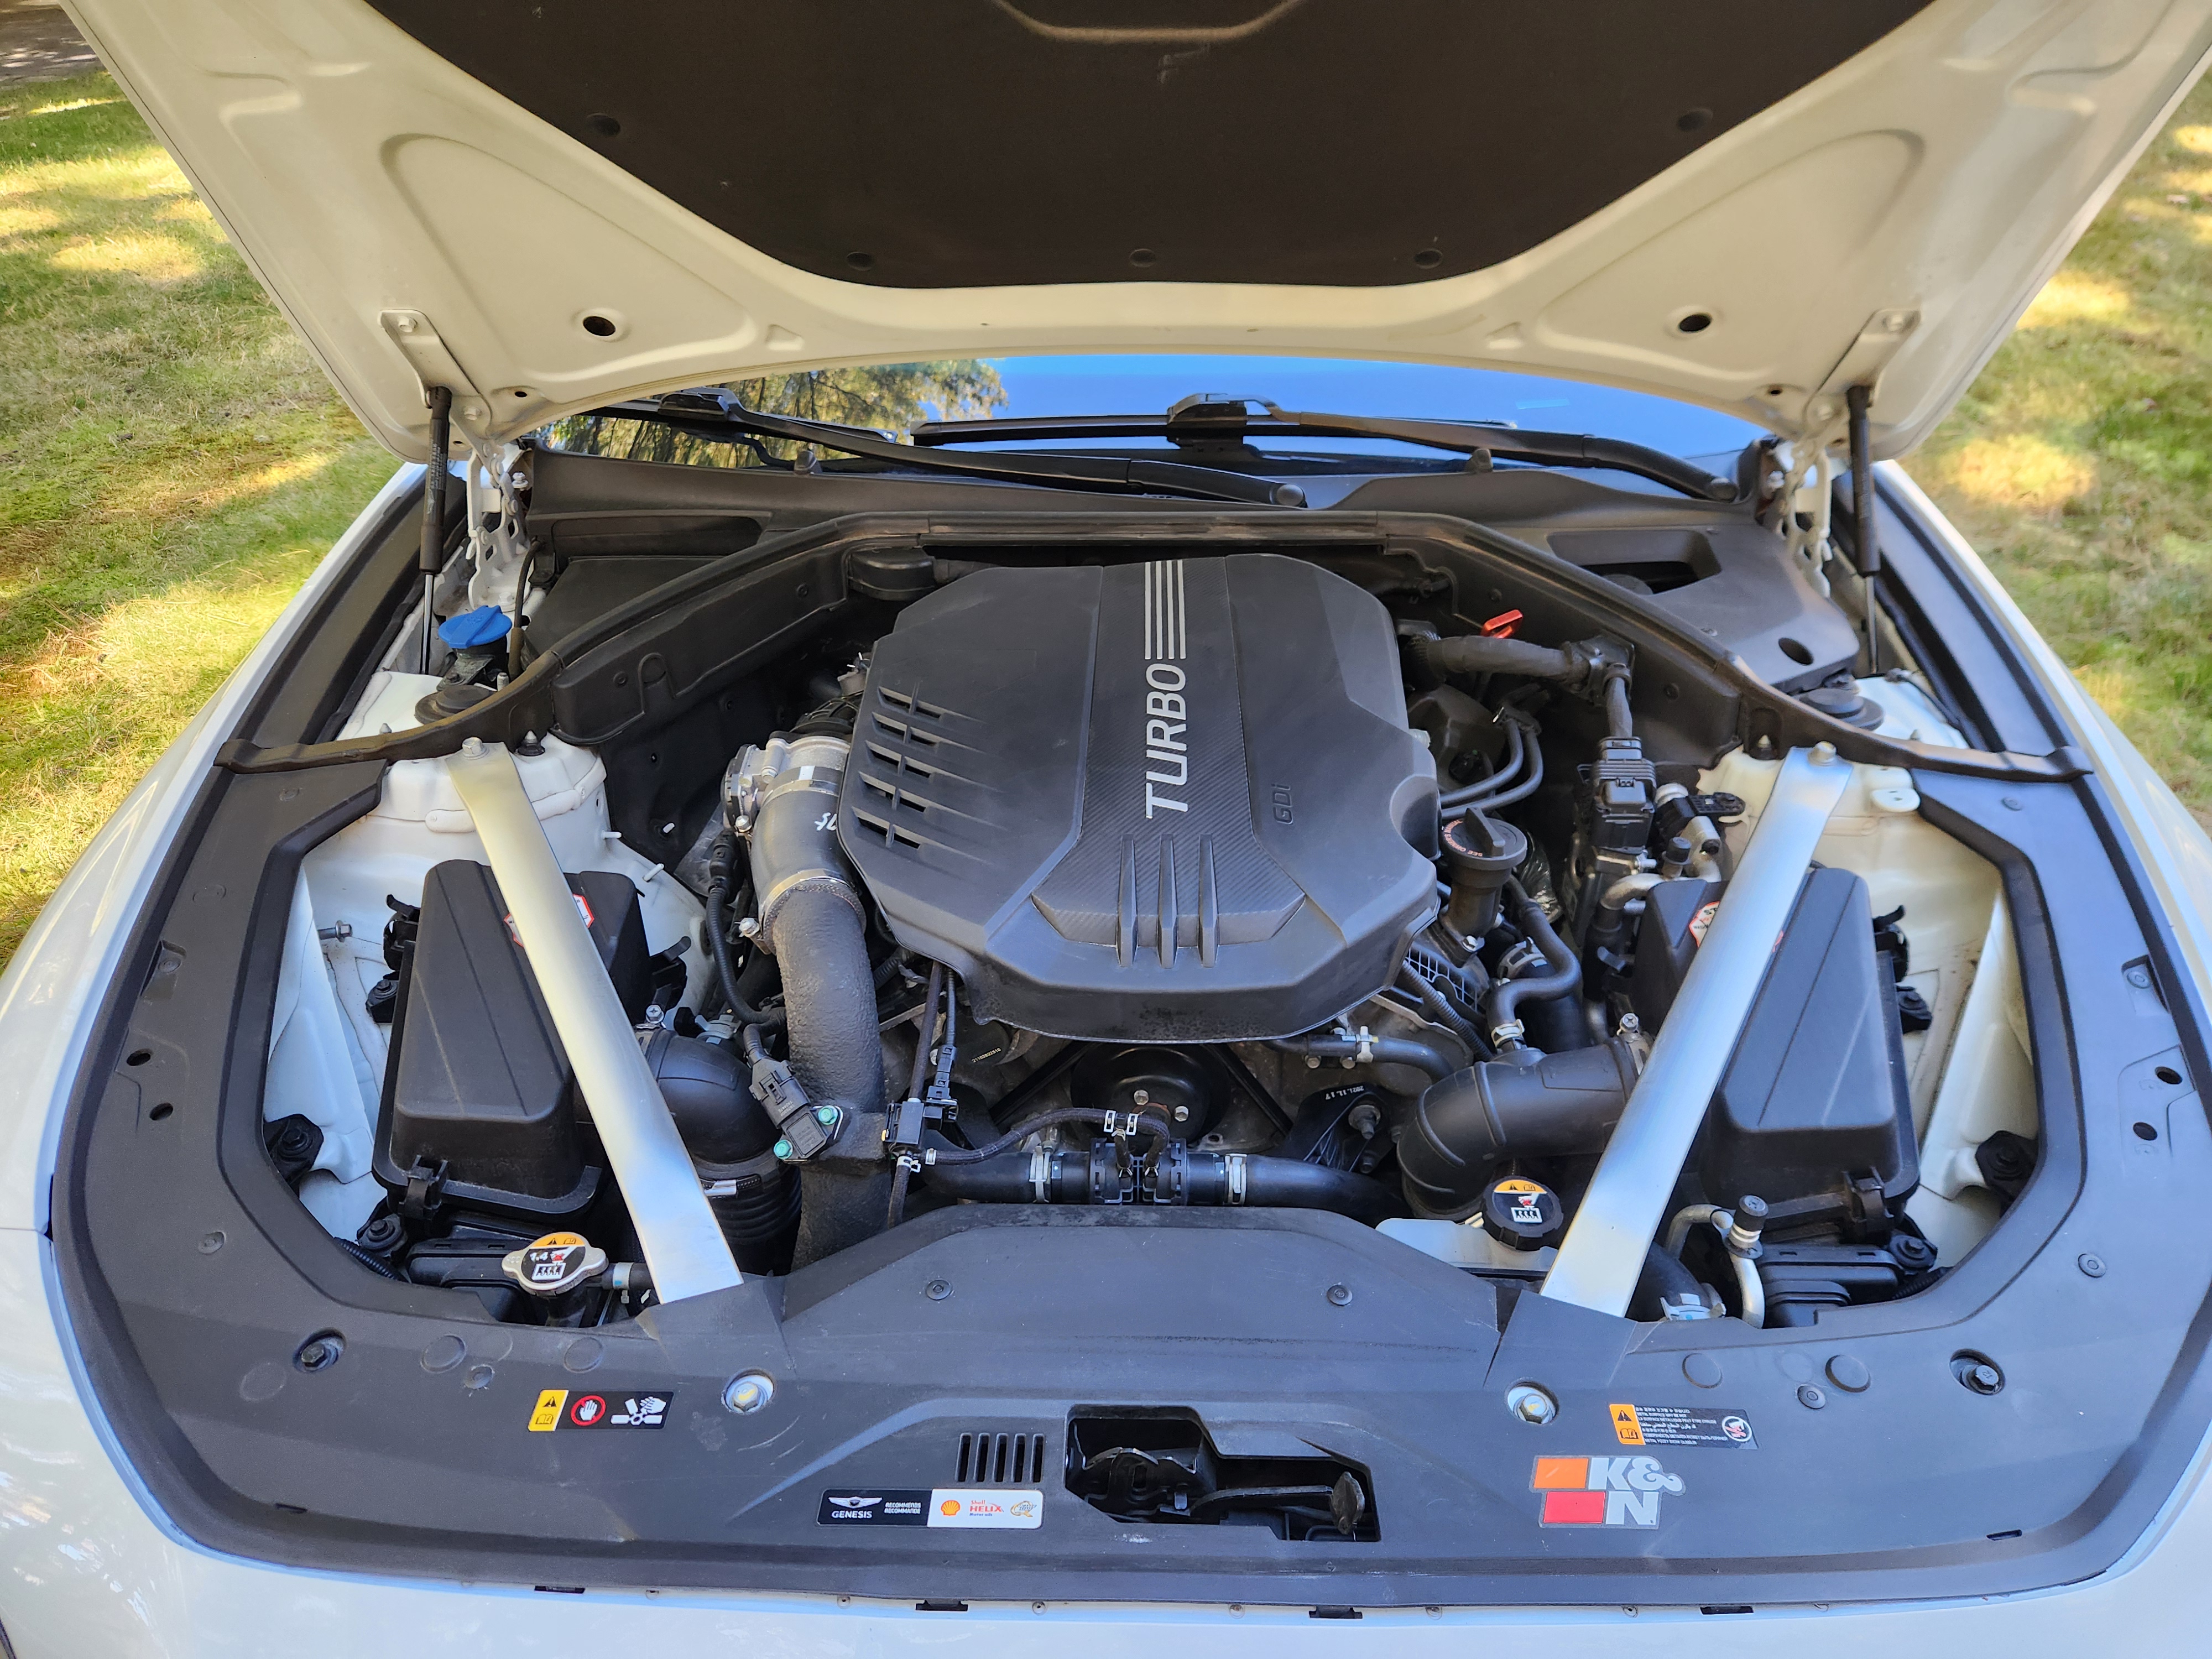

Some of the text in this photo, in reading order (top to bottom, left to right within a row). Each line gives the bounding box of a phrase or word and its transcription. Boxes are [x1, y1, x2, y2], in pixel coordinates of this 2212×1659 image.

[1146, 663, 1188, 819] TURBO
[530, 1251, 548, 1262] 1.4
[831, 1510, 873, 1519] GENESIS
